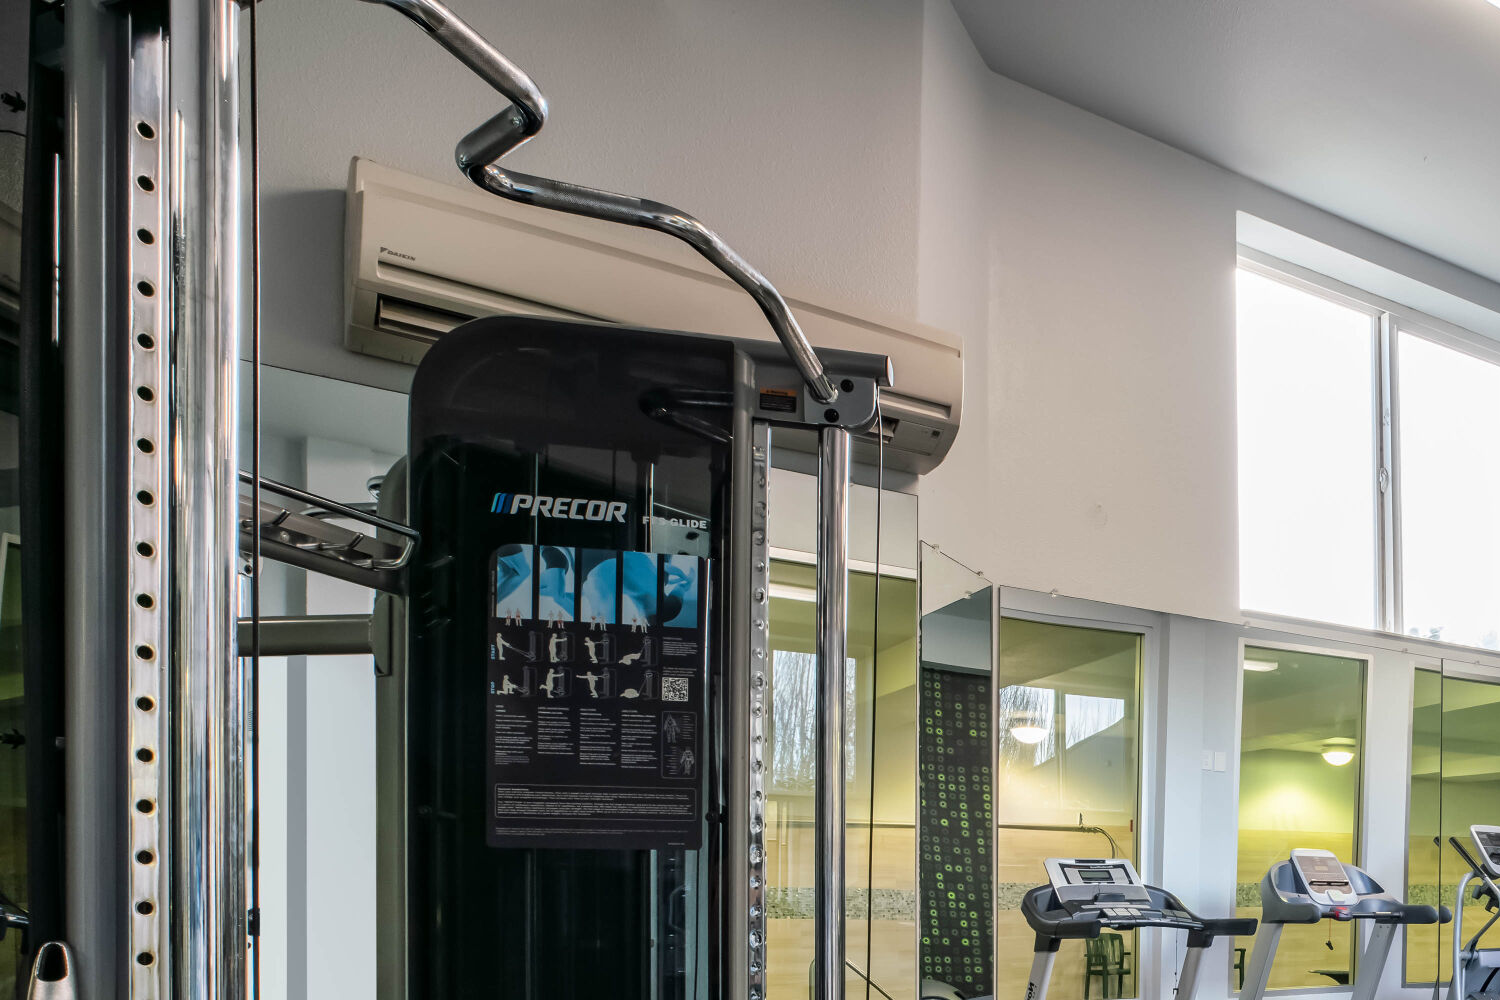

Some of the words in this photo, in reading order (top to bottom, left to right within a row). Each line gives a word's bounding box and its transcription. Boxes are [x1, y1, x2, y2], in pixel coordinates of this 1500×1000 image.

[387, 250, 416, 261] DAIKIN
[510, 494, 628, 524] PRECOR
[670, 518, 708, 529] GLIDE
